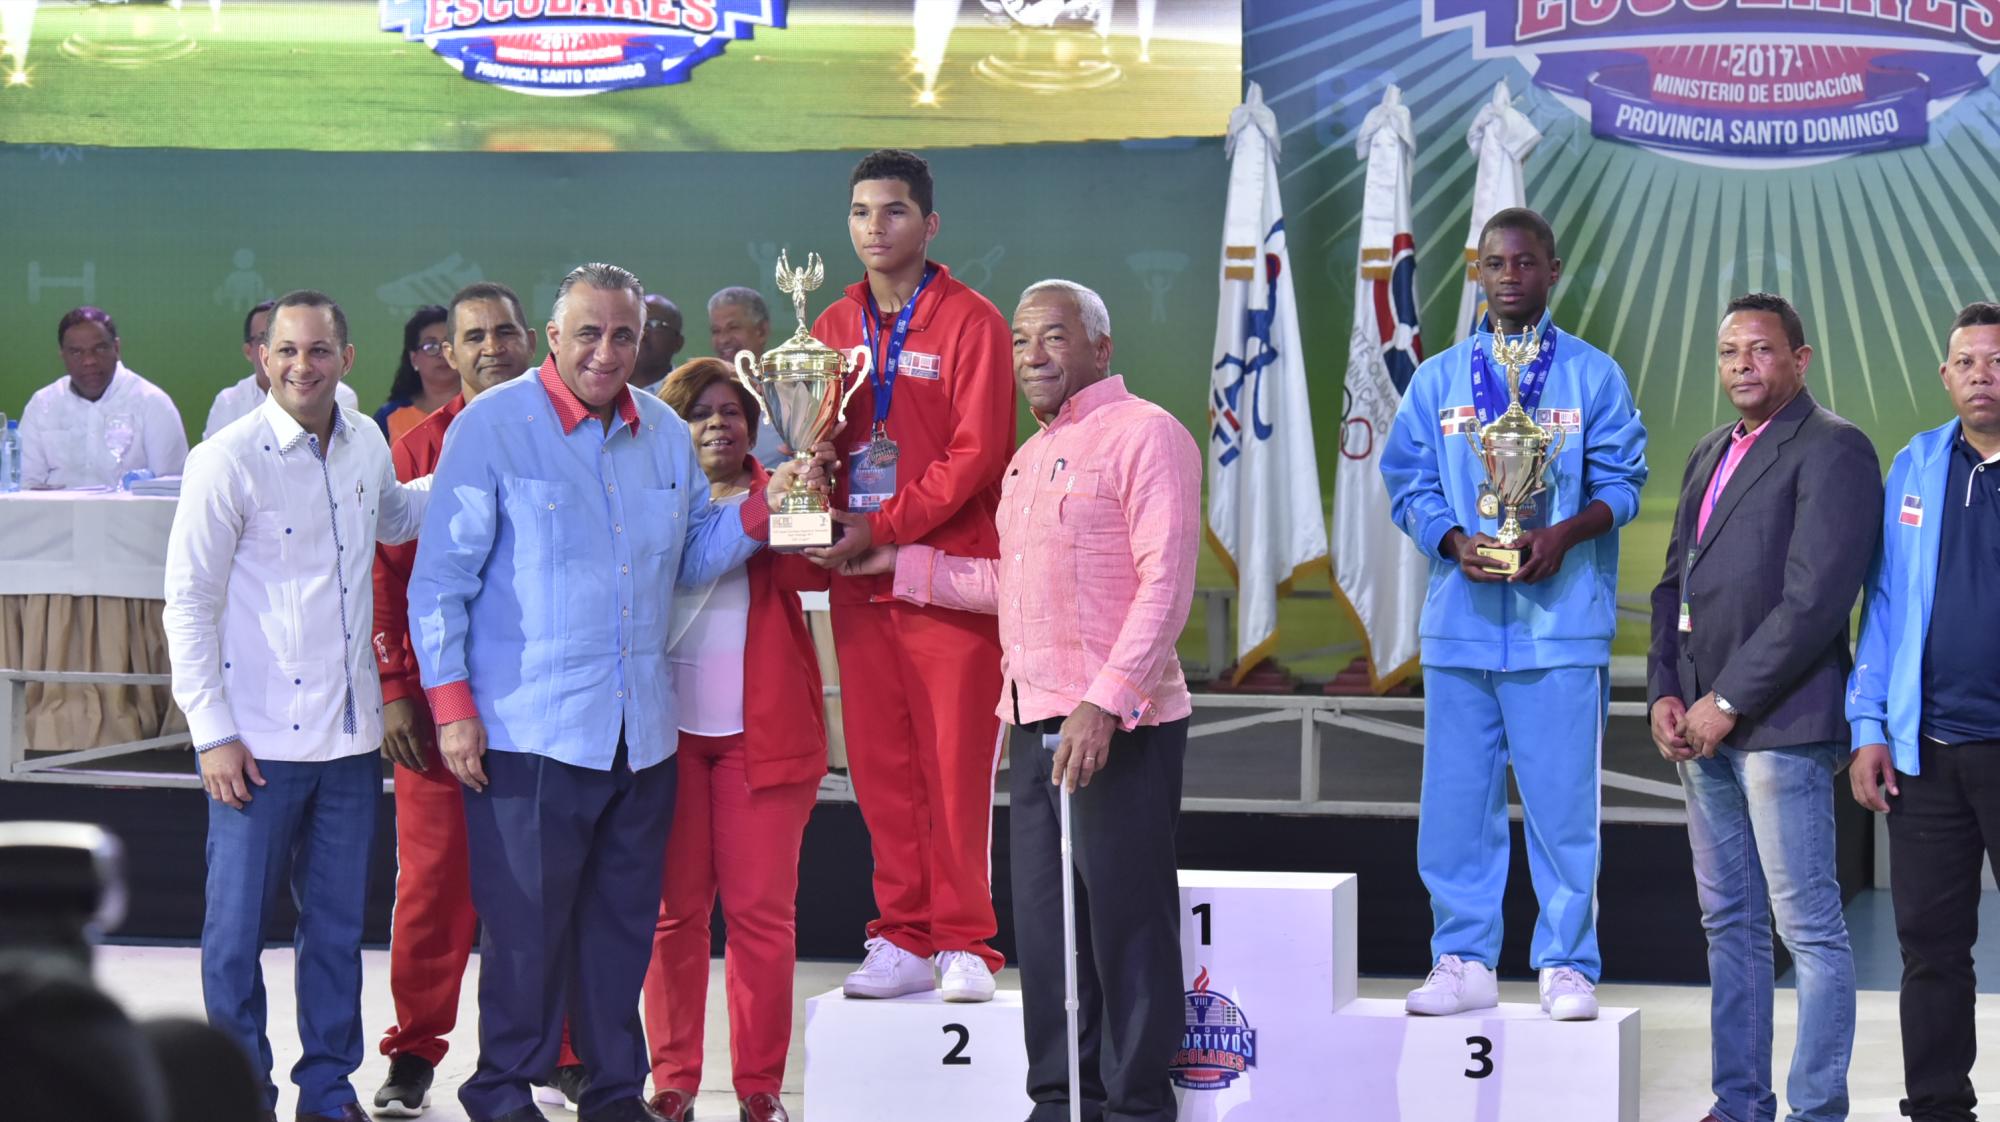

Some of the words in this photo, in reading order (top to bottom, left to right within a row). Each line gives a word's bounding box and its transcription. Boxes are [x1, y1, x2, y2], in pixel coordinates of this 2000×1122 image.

[540, 68, 583, 84] SANTO
[1653, 72, 1745, 103] MINISTERIO
[1748, 83, 1769, 103] DE
[1773, 72, 1864, 103] EDUCACIÓN
[1615, 103, 1725, 143] PROVINCIA
[1729, 120, 1798, 144] SANTO
[1803, 107, 1899, 143] DOMINGO
[1191, 903, 1211, 945] 1
[1194, 997, 1208, 1005] VIII
[942, 1023, 971, 1065] 2
[1182, 1031, 1253, 1057] ORTIVOS
[1464, 1035, 1494, 1079] 3
